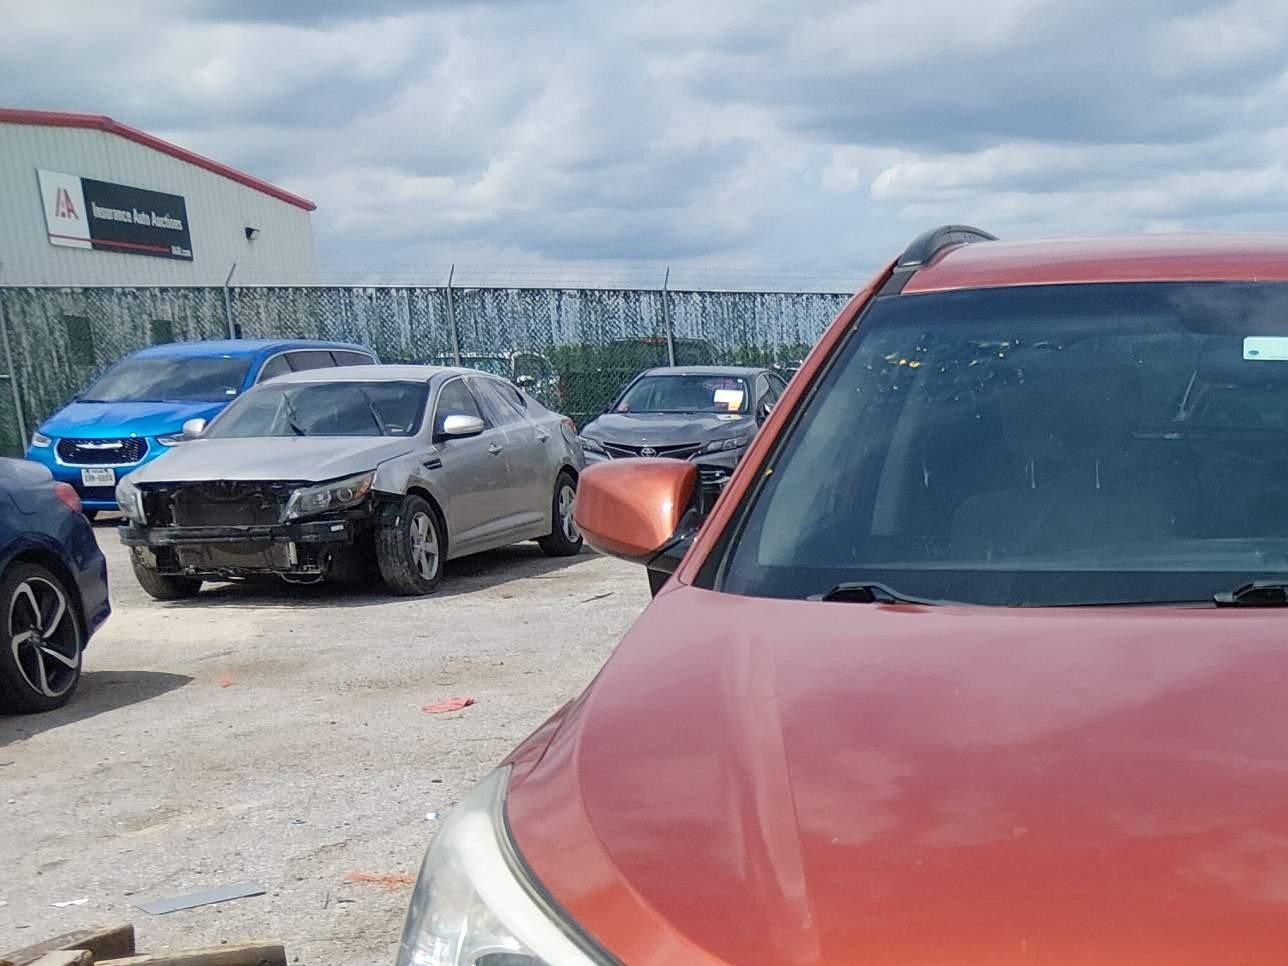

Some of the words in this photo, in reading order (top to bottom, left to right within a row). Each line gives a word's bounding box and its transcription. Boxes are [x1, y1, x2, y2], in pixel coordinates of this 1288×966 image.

[91, 201, 133, 224] Insurance
[133, 208, 151, 226] Auto
[151, 211, 184, 231] Auctions
